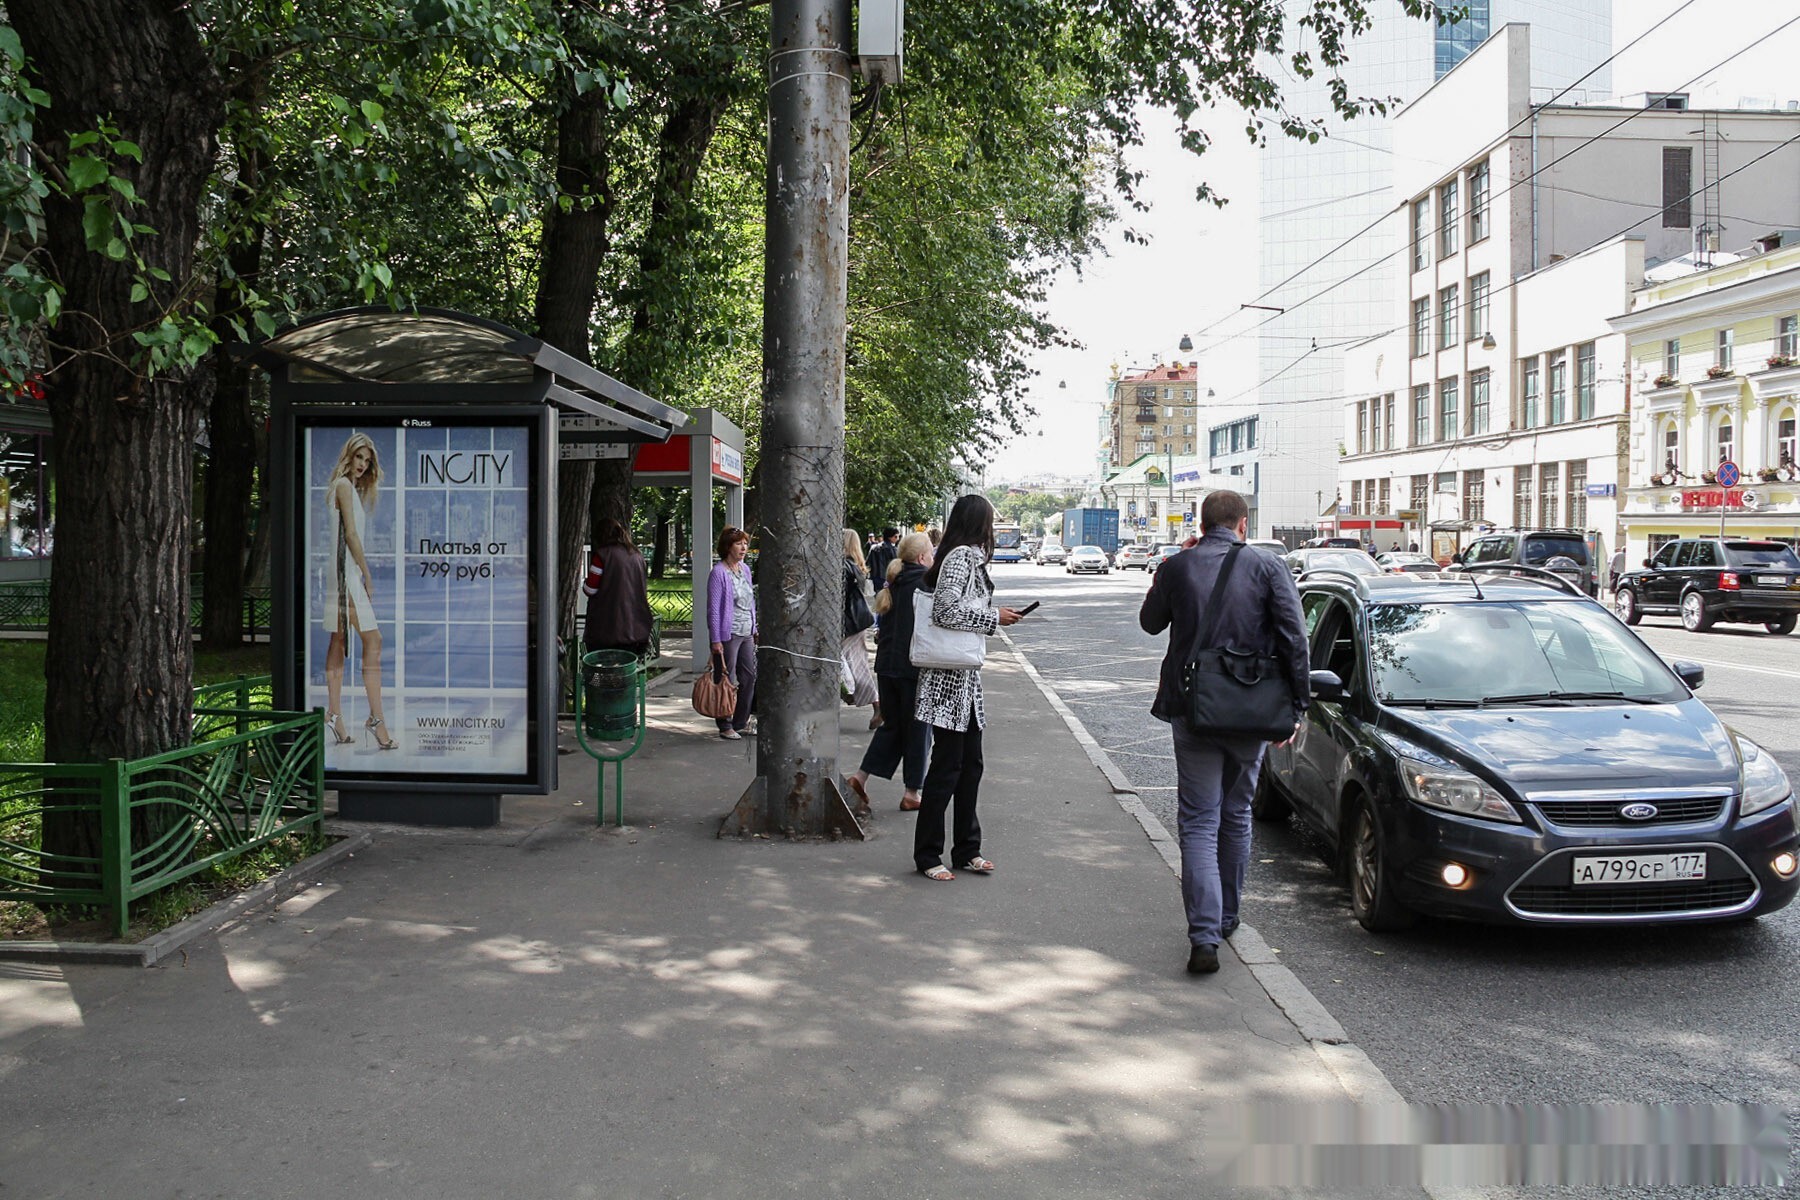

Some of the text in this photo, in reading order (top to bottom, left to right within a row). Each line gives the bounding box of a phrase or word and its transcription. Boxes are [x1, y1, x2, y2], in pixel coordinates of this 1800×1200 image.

[411, 419, 432, 427] Russ
[419, 452, 510, 485] INCITY
[419, 539, 507, 555] Платья от
[419, 562, 496, 581] 799 руб.
[416, 717, 506, 729] WWW.INCITY.RU
[1670, 855, 1700, 871] 177
